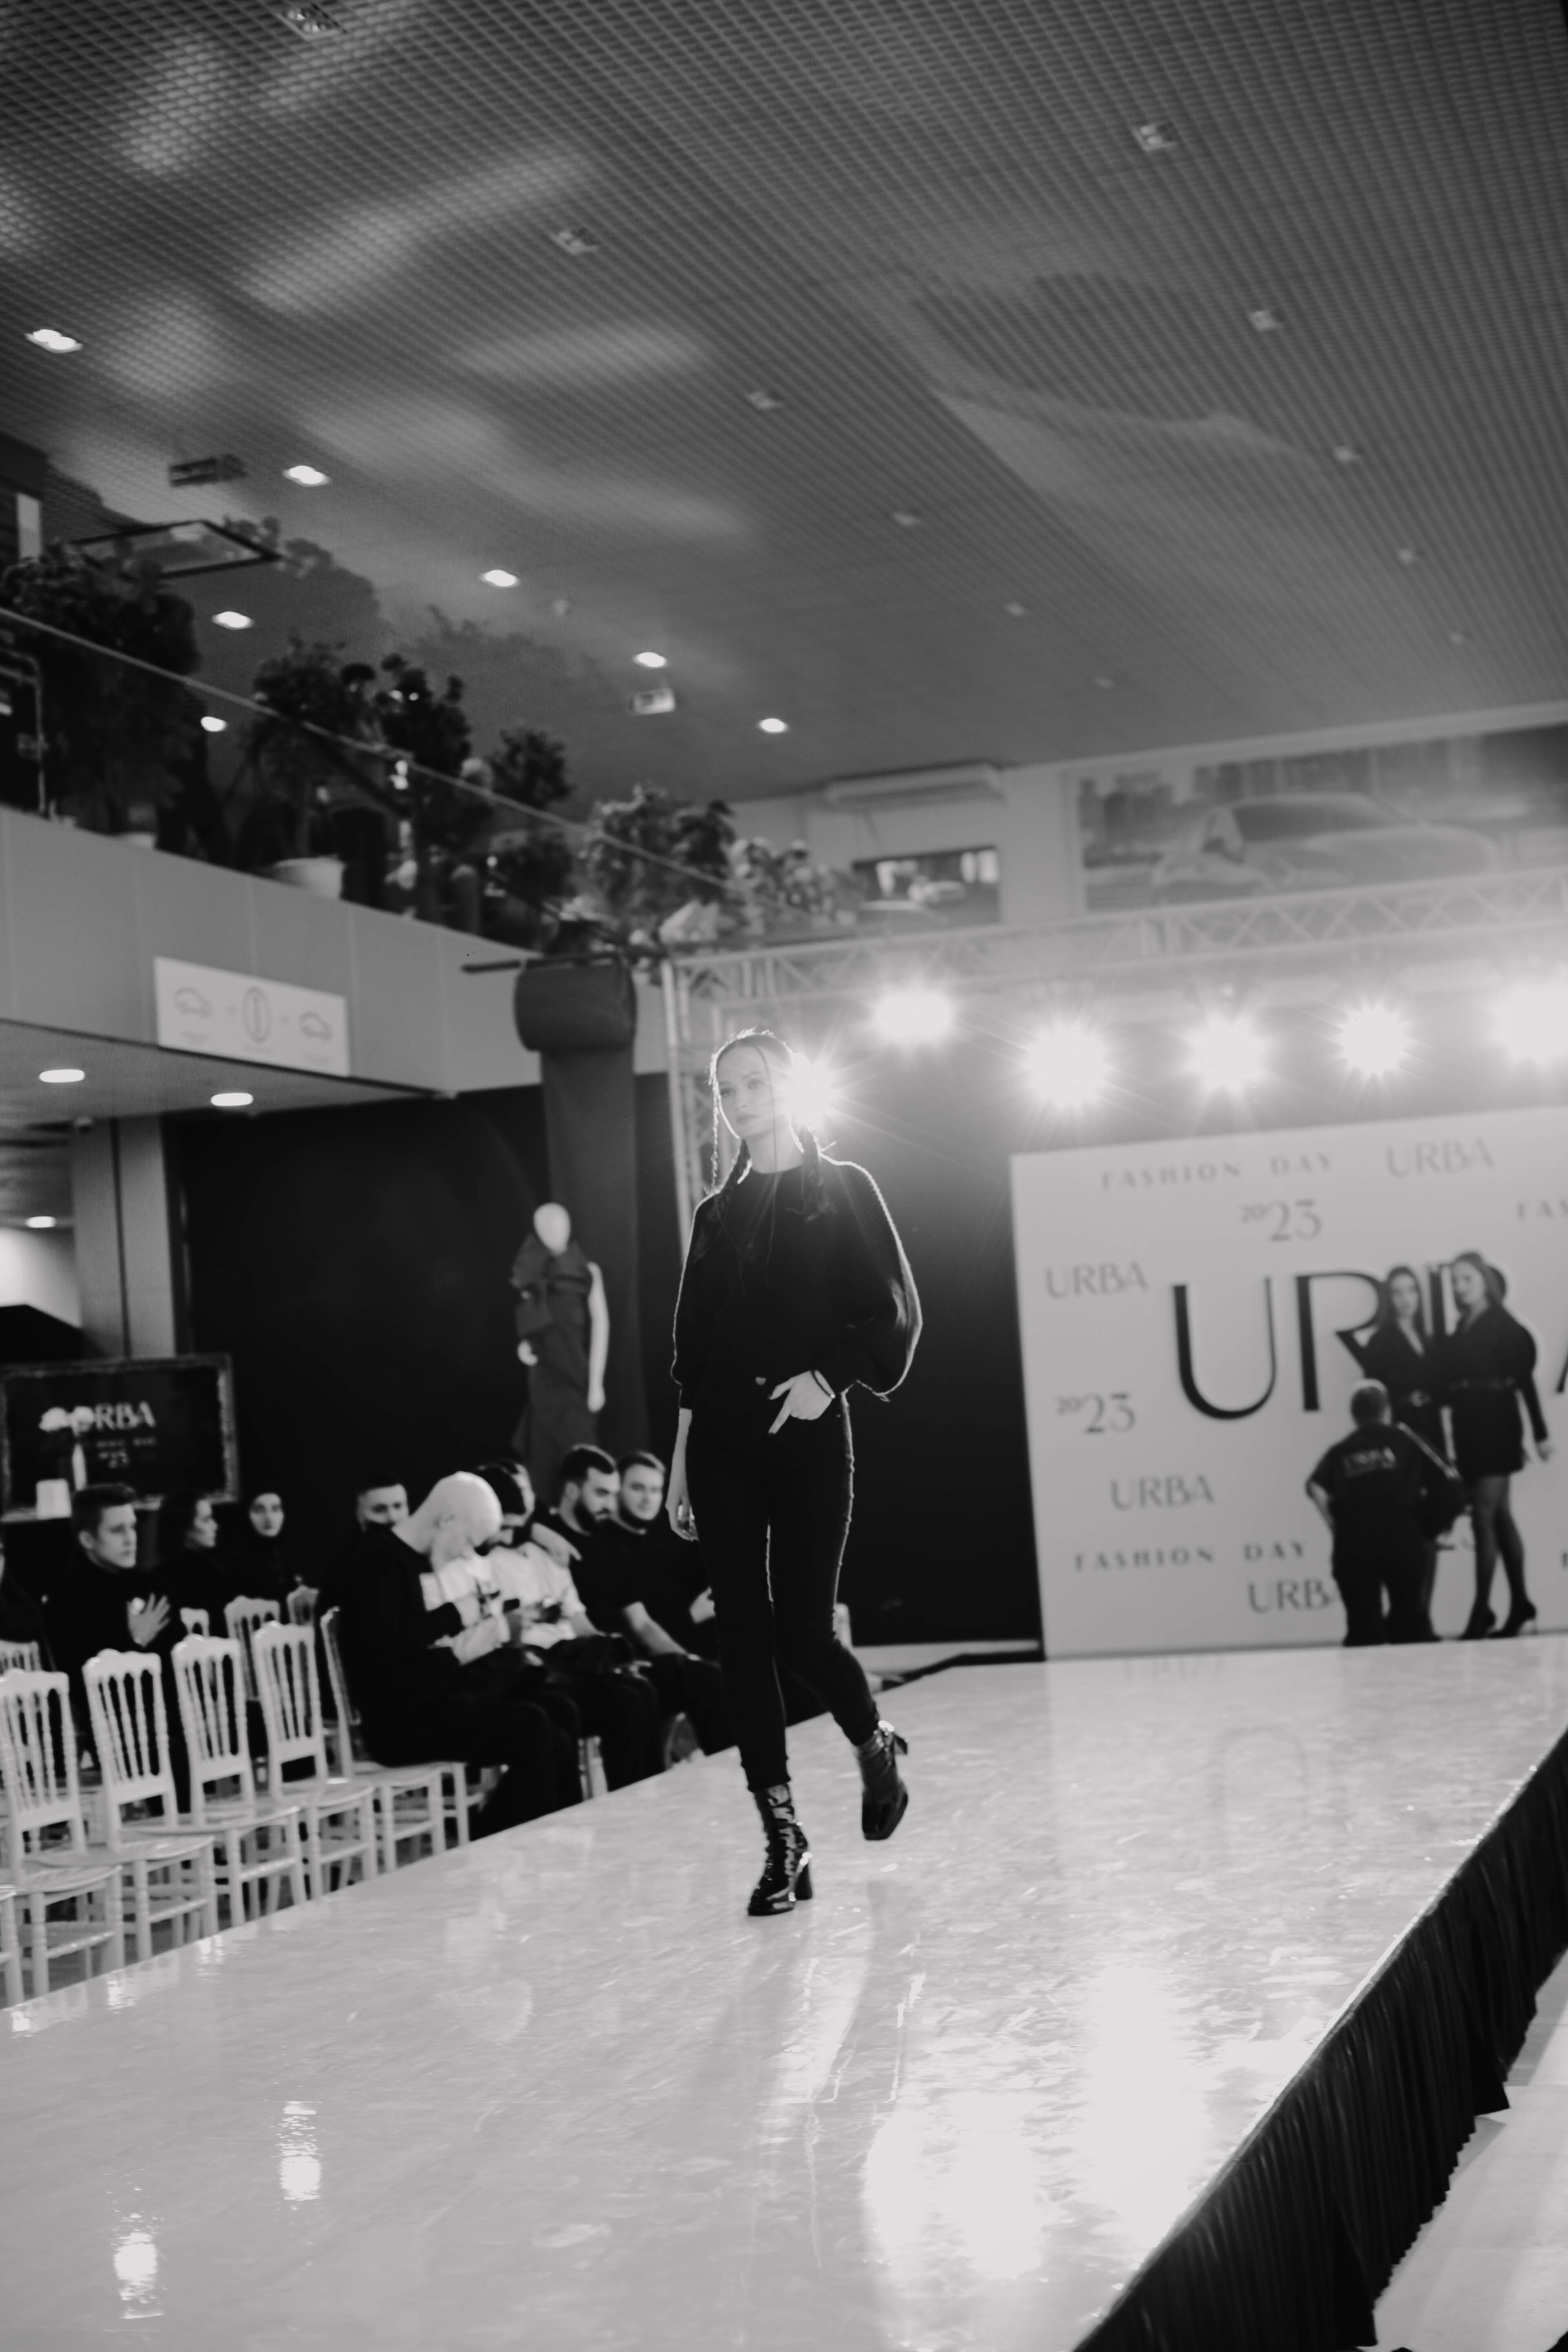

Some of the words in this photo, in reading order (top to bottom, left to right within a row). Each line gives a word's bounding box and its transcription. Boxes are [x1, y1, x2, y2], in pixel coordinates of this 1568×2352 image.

[1101, 1163, 1241, 1191] FASHION
[1270, 1152, 1331, 1176] DAY
[1386, 1137, 1494, 1178] URBA
[1045, 1260, 1149, 1300] URBA
[94, 1400, 156, 1430] RBA
[1110, 1474, 1215, 1511] URBA
[1074, 1546, 1215, 1572] FASHION
[1243, 1540, 1306, 1562] DAY
[1248, 1578, 1338, 1614] URB
